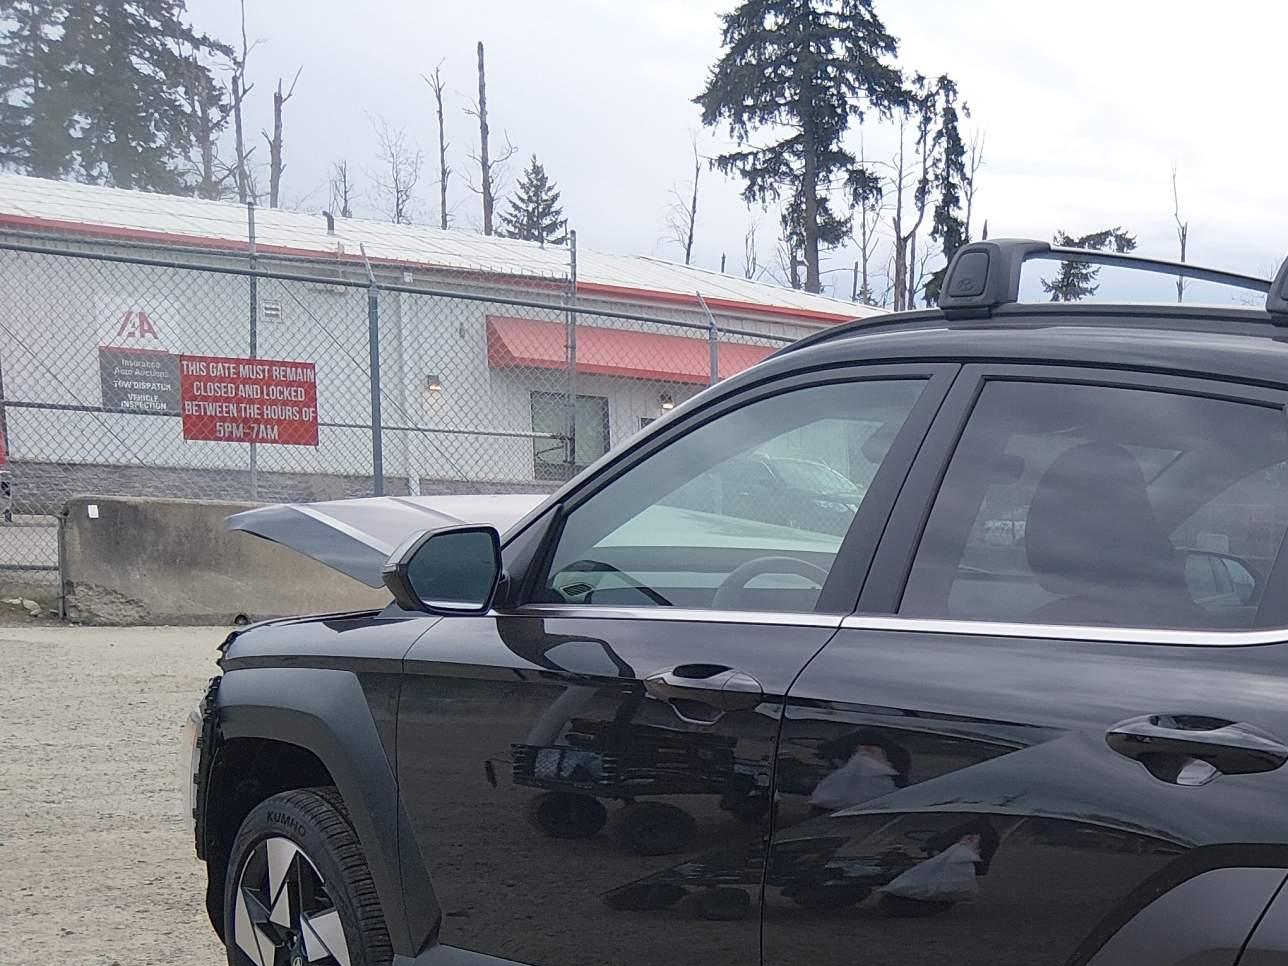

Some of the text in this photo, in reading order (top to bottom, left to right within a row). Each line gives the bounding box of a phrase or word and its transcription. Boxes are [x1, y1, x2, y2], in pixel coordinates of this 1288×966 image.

[121, 358, 162, 369] Insurance
[182, 360, 315, 383] THIS GATE MUST REMAIN
[113, 379, 172, 391] TOW DISPATCH
[193, 382, 305, 401] CLOSED AND LOCKED
[120, 400, 167, 410] INSPECTION
[127, 393, 159, 402] VEHICLE
[184, 401, 316, 422] BETWEEN THE HOURS OF
[215, 422, 280, 440] 5PM-7AM
[266, 810, 306, 838] KUMHO
